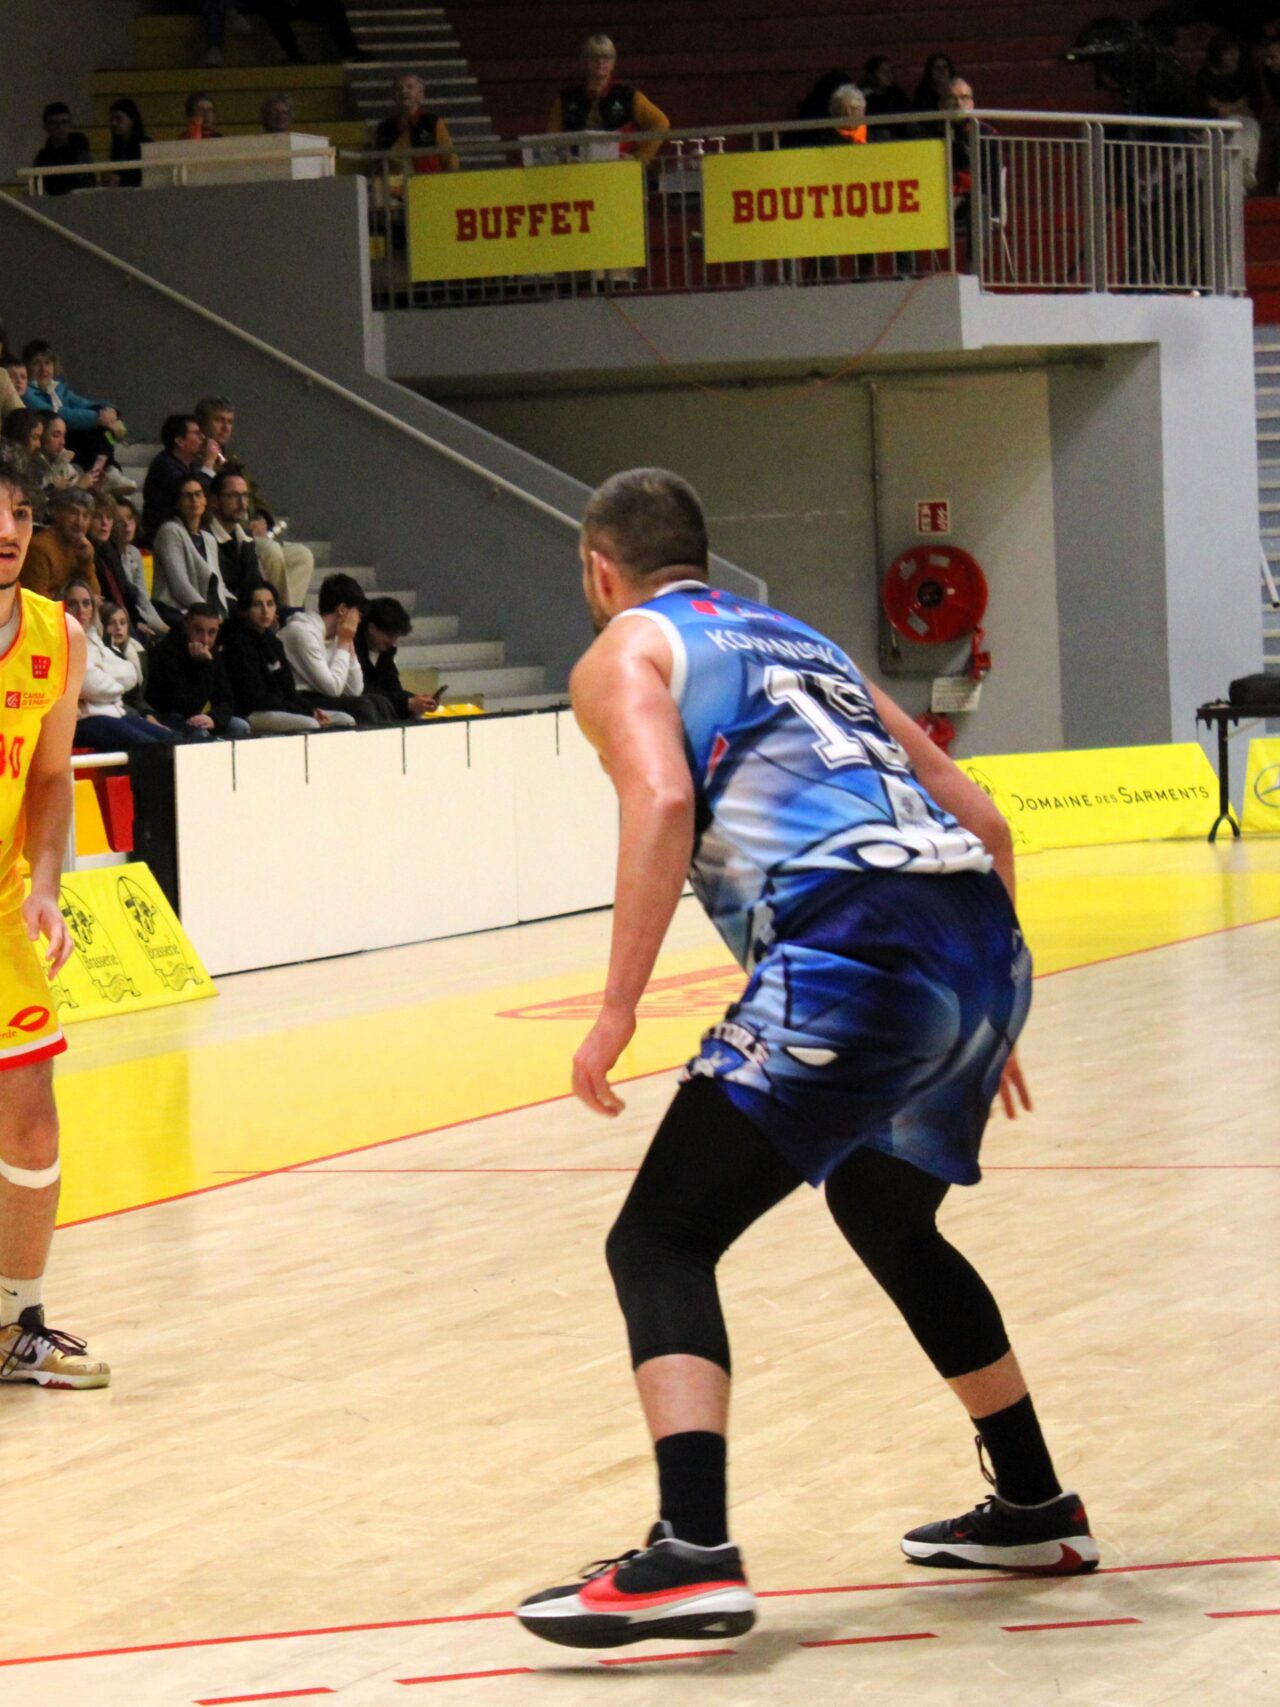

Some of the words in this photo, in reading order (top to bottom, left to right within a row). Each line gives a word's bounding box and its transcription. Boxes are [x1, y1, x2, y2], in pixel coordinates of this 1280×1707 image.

[456, 200, 594, 241] BUFFET
[732, 178, 920, 224] BOUTIQUE
[1095, 794, 1118, 805] DES
[1117, 786, 1210, 806] SARMENTS
